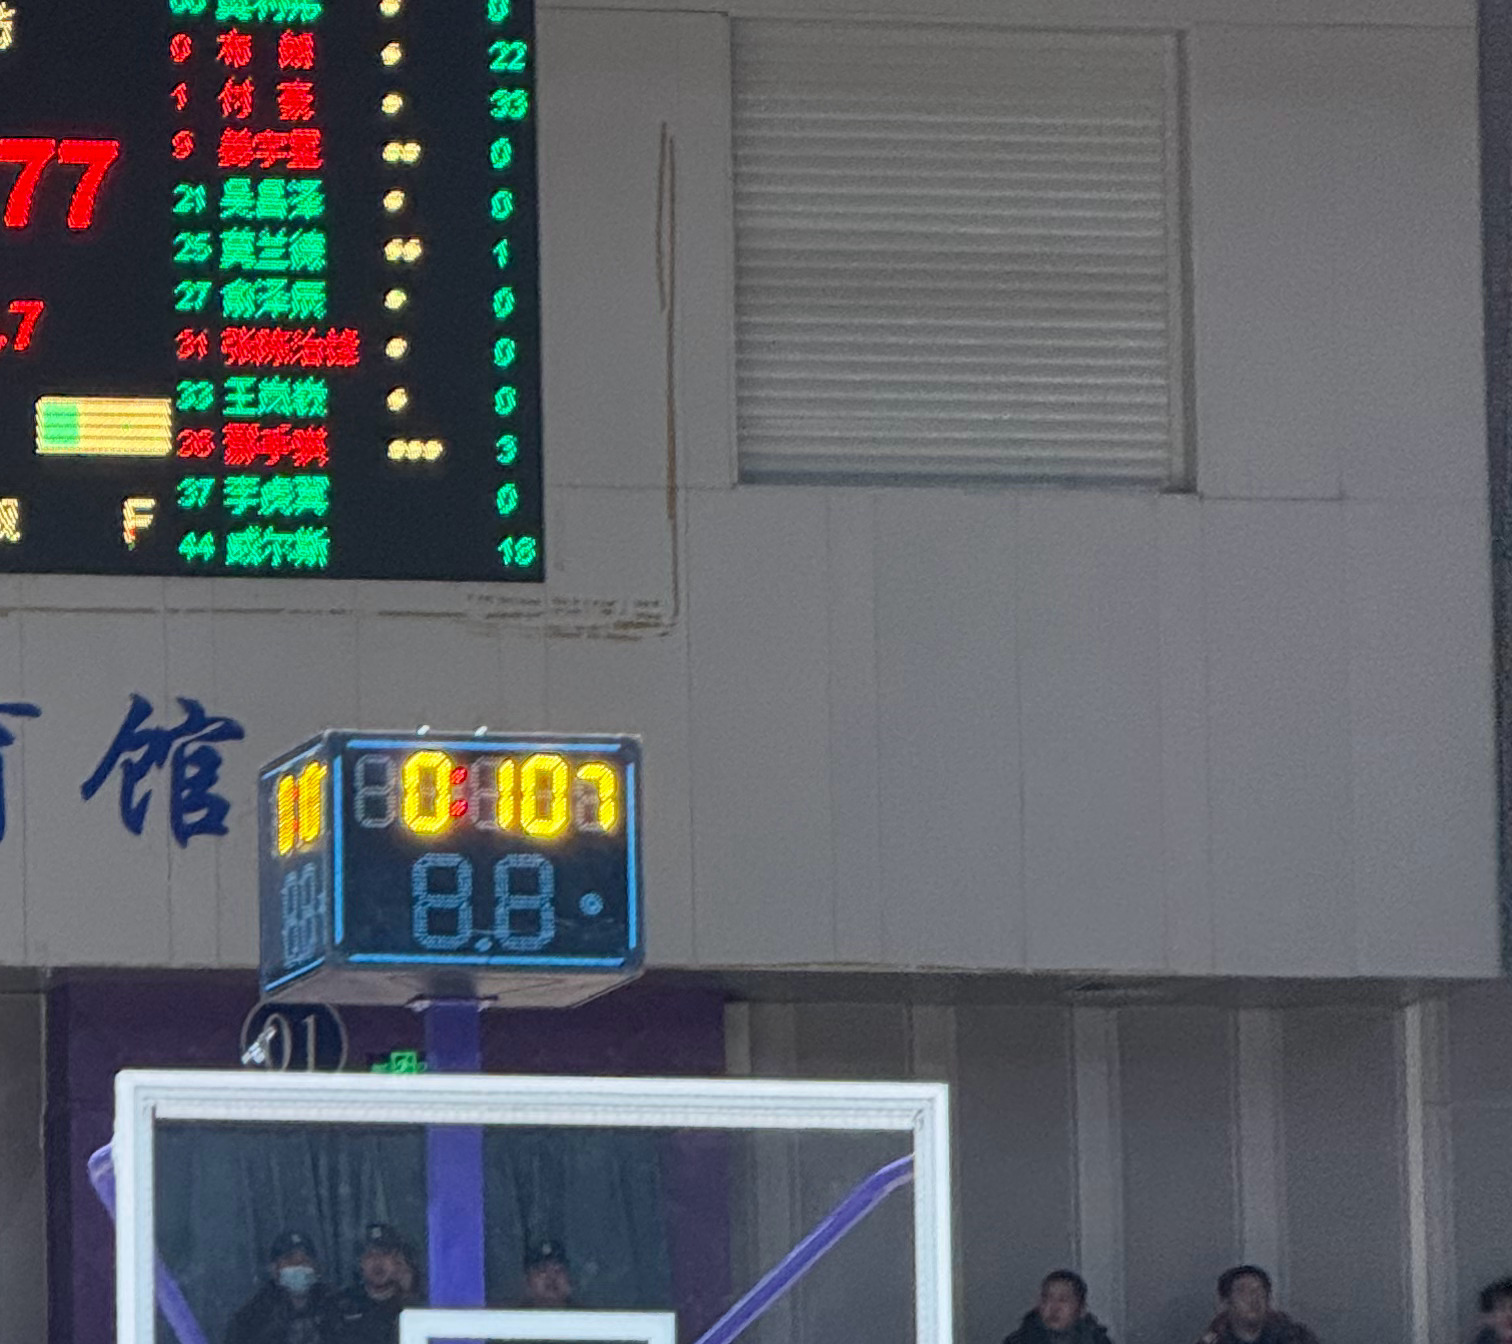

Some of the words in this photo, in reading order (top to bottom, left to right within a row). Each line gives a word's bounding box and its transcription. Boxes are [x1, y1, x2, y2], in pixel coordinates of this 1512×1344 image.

[169, 33, 193, 63] 0
[488, 40, 528, 71] 22
[169, 82, 188, 111] 1
[217, 75, 316, 121] 付豪
[490, 137, 513, 169] 0
[172, 183, 206, 214] 21
[490, 190, 514, 221] 0
[173, 231, 213, 263] 25
[492, 238, 509, 269] 1
[173, 279, 213, 311] 27
[492, 286, 516, 319] 0
[493, 337, 516, 368] 0
[494, 386, 517, 416] 0
[495, 434, 518, 464] 3
[176, 477, 216, 508] 37
[496, 483, 519, 515] 0
[122, 497, 156, 550] F
[178, 531, 216, 562] 44
